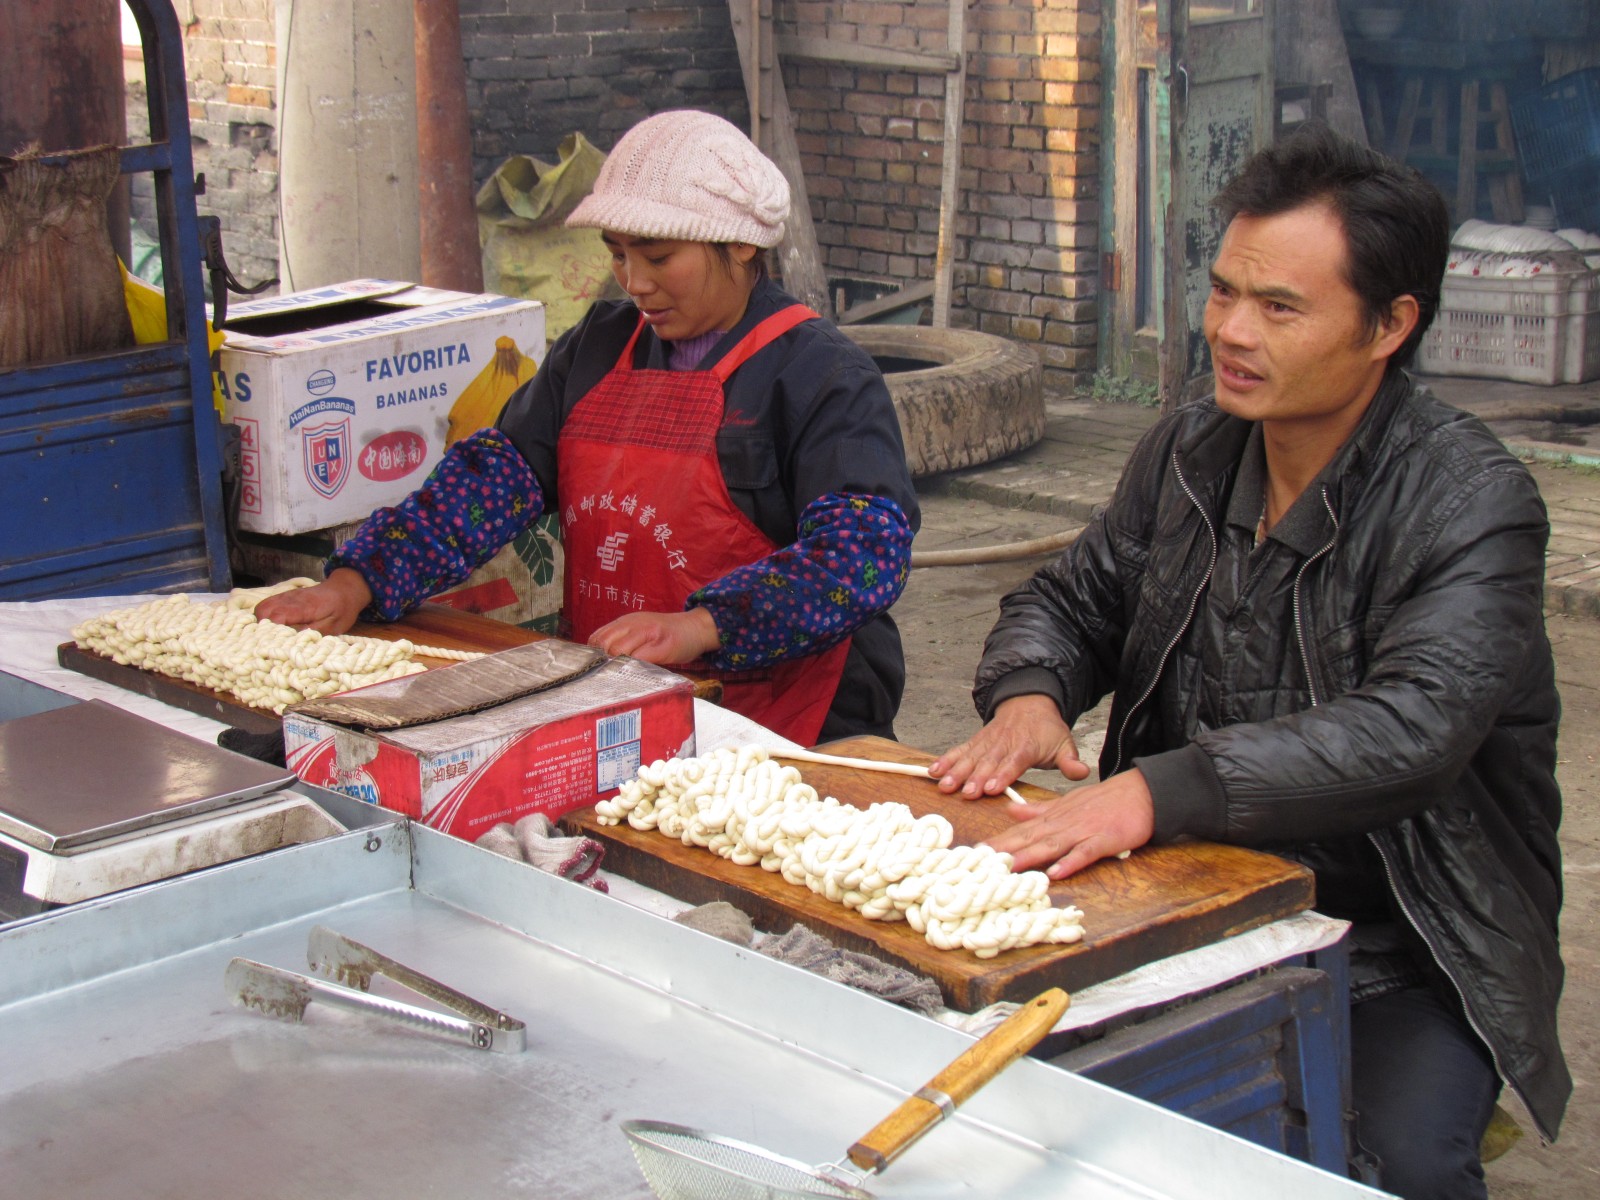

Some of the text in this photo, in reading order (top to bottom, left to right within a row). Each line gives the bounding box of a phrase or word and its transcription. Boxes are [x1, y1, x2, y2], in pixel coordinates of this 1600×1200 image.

[366, 342, 471, 383] FAVORITA
[376, 382, 448, 410] BANANAS
[290, 400, 355, 426] HaiNanBananas
[364, 437, 421, 478] 中国海南
[433, 760, 469, 783] 草莓味
